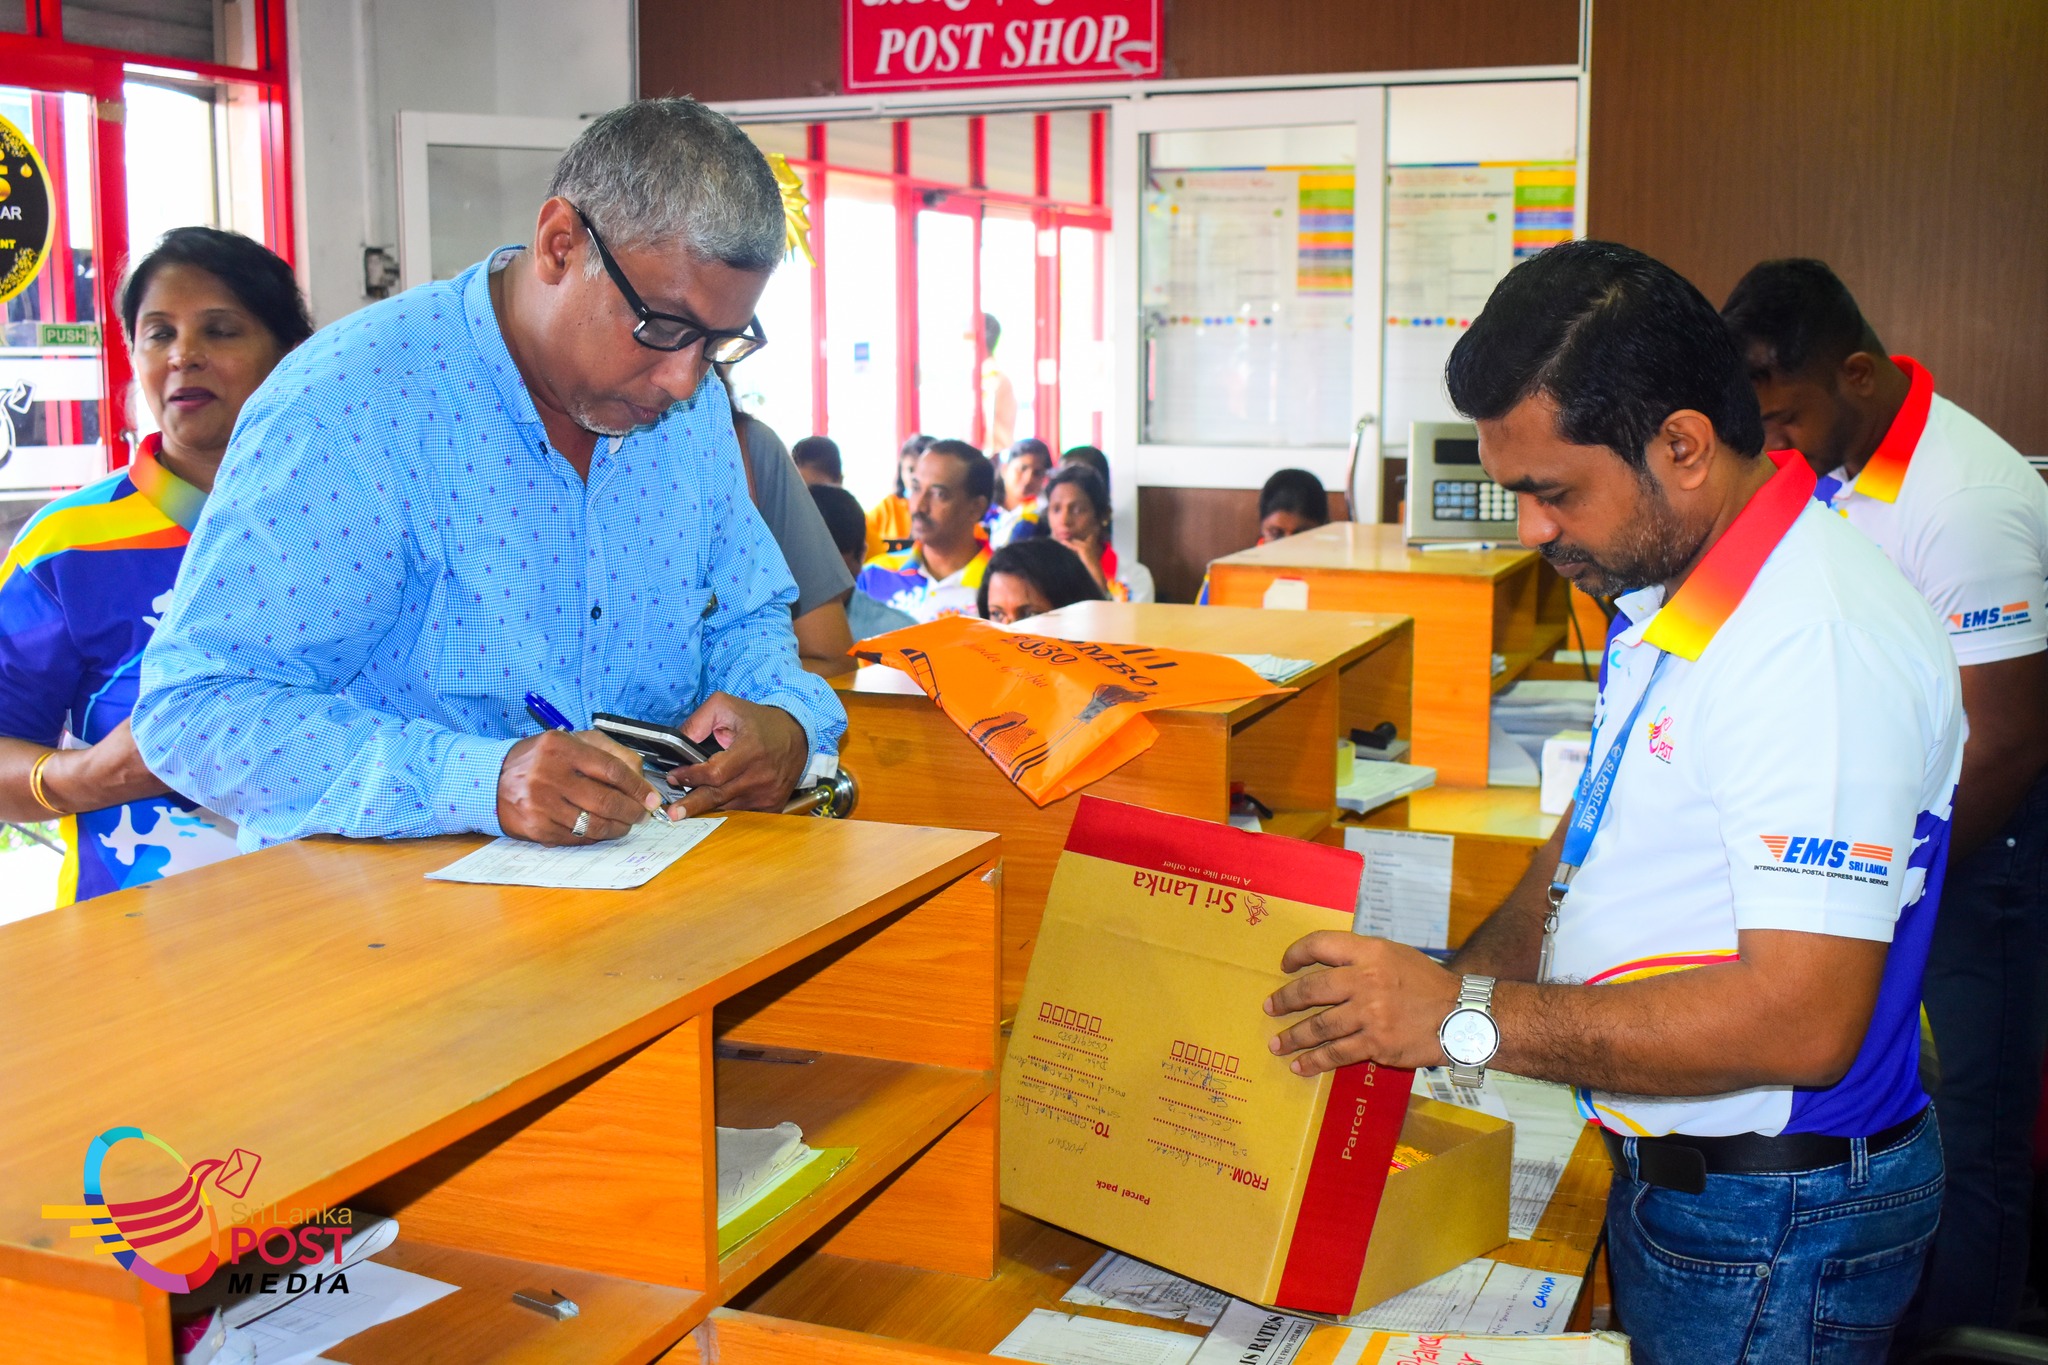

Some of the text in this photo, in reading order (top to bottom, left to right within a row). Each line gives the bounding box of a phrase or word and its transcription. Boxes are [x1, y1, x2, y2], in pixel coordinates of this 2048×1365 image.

[875, 15, 1130, 75] POST SHOP
[0, 205, 22, 220] AR
[0, 239, 16, 249] NT
[47, 328, 86, 343] PUSH
[1962, 607, 2000, 628] EMS
[1579, 758, 1616, 832] SL POST-CME
[1783, 836, 1849, 868] EMS
[1163, 860, 1186, 871] other
[1203, 869, 1219, 880] like
[1754, 865, 1889, 886] INTERNATIONAL POSTAL EXPRESS MAIL SERVICE
[1848, 860, 1888, 876] SRI LANKA
[1220, 872, 1241, 885] land
[1243, 877, 1251, 886] A
[1133, 871, 1237, 913] Sri Lanka
[1363, 1062, 1377, 1087] pa
[1341, 1097, 1368, 1160] Parcel
[1229, 1167, 1269, 1191] FROM:
[1096, 1180, 1151, 1205] Parcel pack
[1532, 1277, 1557, 1309] CANADA
[1248, 1315, 1285, 1352] RATES
[1283, 1341, 1295, 1359] FROM
